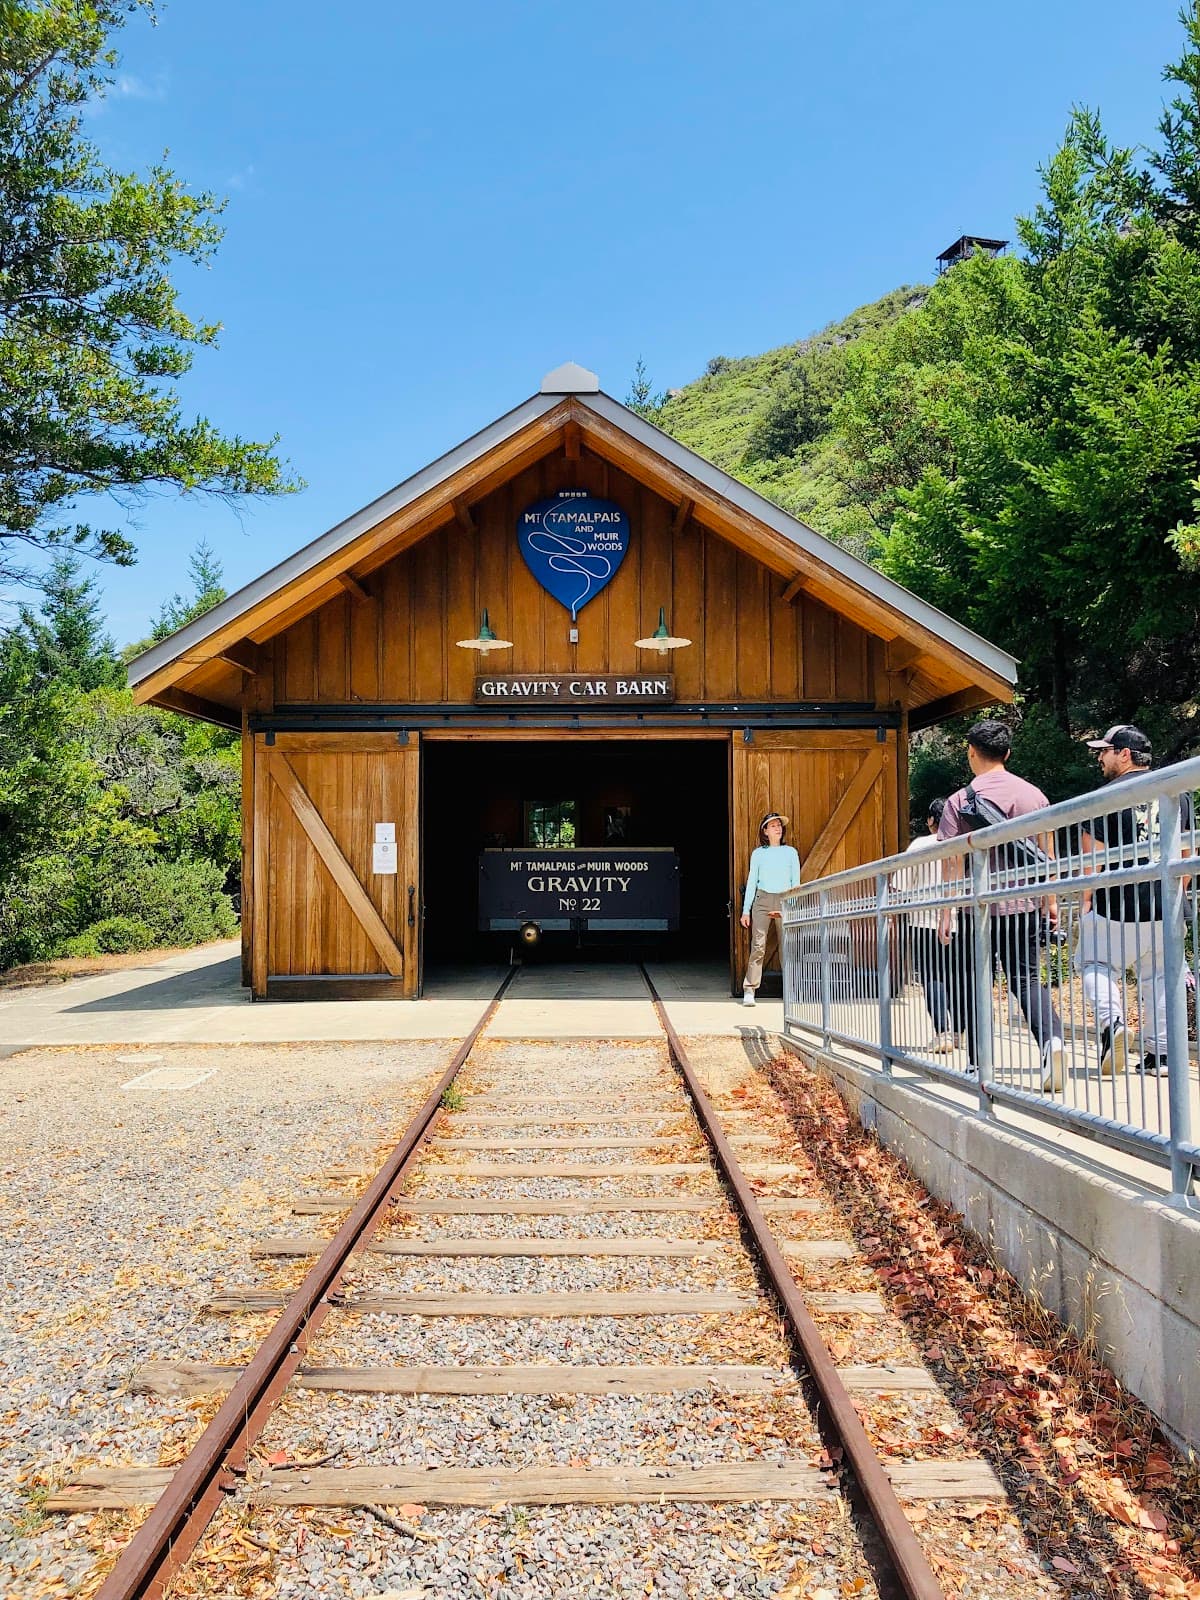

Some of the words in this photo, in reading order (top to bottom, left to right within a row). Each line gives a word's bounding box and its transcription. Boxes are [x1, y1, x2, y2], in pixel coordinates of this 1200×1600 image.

[550, 512, 621, 523] TAMALPAIS
[594, 533, 619, 541] MUIR
[587, 543, 623, 551] WOODS
[481, 681, 561, 696] GRAVITY
[569, 681, 608, 696] CAR
[616, 681, 667, 695] BARN
[525, 861, 576, 872] TAMALPAIS
[587, 861, 611, 872] MUIR
[614, 861, 649, 872] WOODS
[527, 877, 631, 892] GRAVITY
[582, 898, 601, 911] 22
